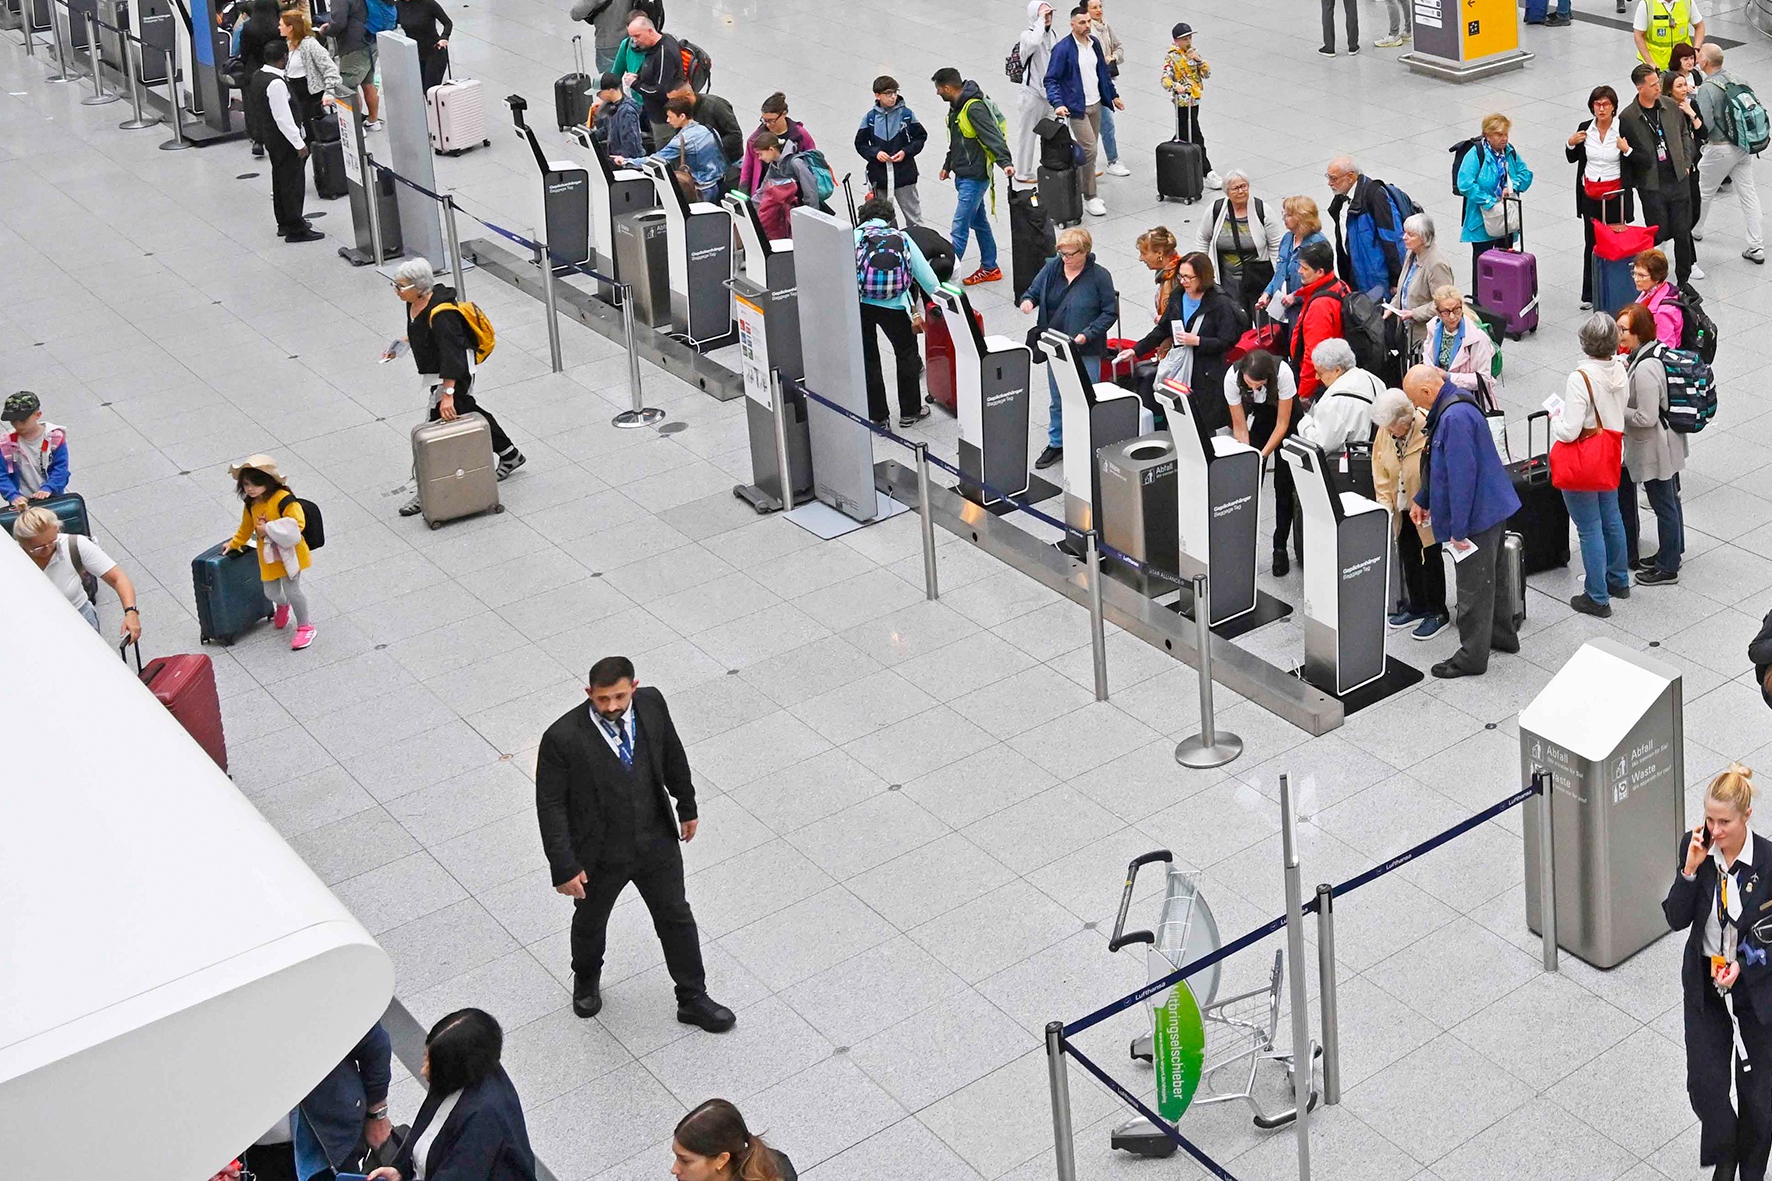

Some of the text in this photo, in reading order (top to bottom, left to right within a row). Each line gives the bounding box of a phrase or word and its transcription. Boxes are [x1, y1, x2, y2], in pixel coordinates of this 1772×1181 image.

[1155, 463, 1174, 475] Abfall
[1214, 495, 1252, 512] Gepäckanhänger
[1342, 555, 1382, 574] Gepäckanhänger
[1546, 745, 1568, 764] Abfall
[1631, 739, 1654, 761] Abfall
[1631, 763, 1656, 784] Waste
[1508, 789, 1532, 805] Lufthansa
[1386, 853, 1412, 869] Lufthansa
[1134, 981, 1166, 1001] Lufthansa
[1167, 985, 1184, 1099] Mitbringselschieber
